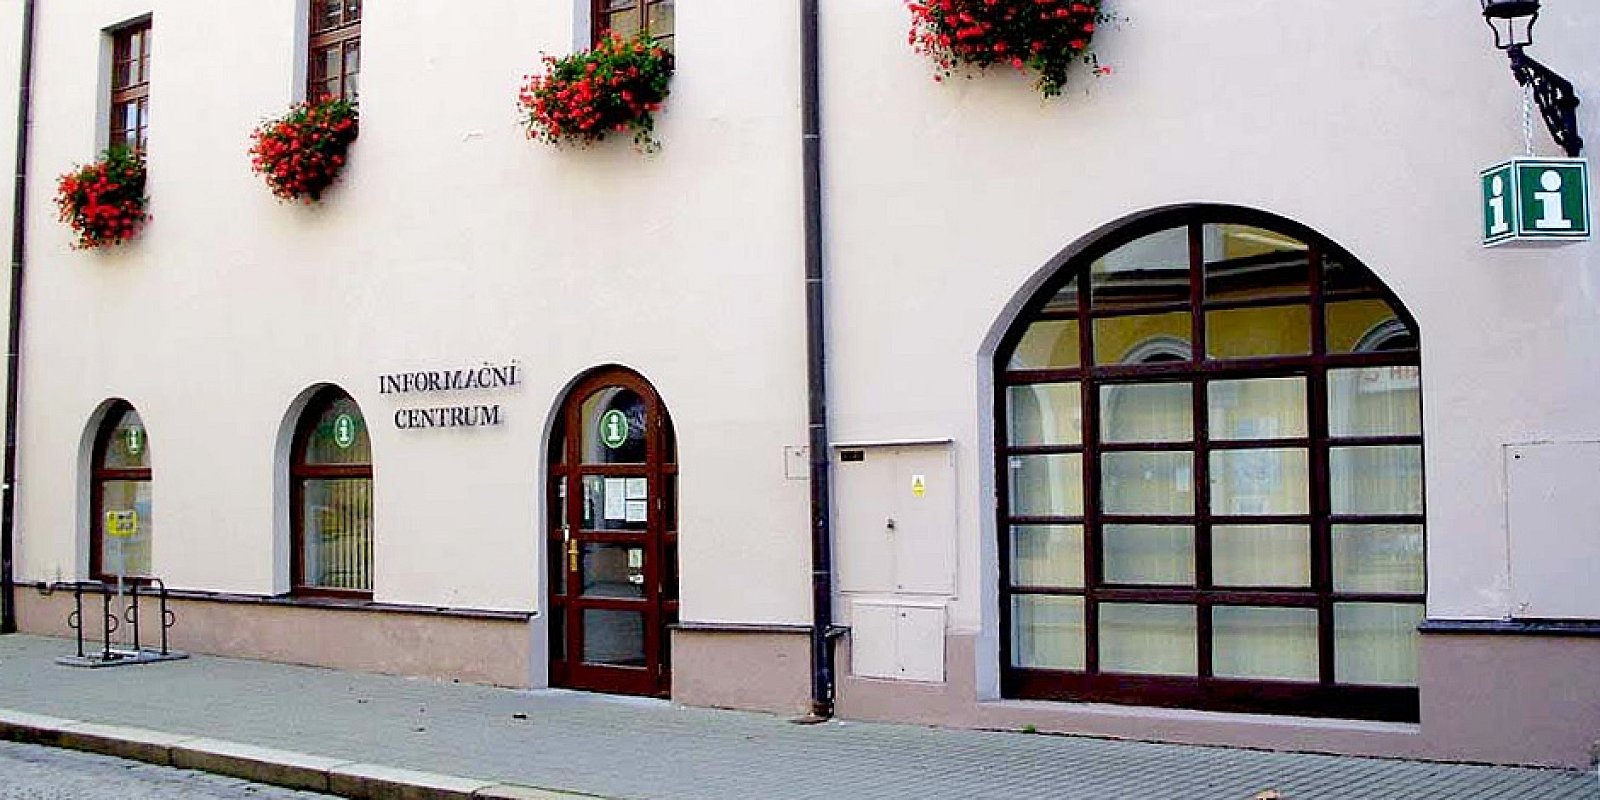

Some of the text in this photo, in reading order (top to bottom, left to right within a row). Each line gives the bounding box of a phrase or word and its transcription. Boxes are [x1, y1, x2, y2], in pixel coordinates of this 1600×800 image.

[1489, 175, 1508, 235] i
[1534, 170, 1571, 228] i
[379, 359, 518, 394] INFORMAČNÍ
[394, 405, 500, 429] CENTRUM
